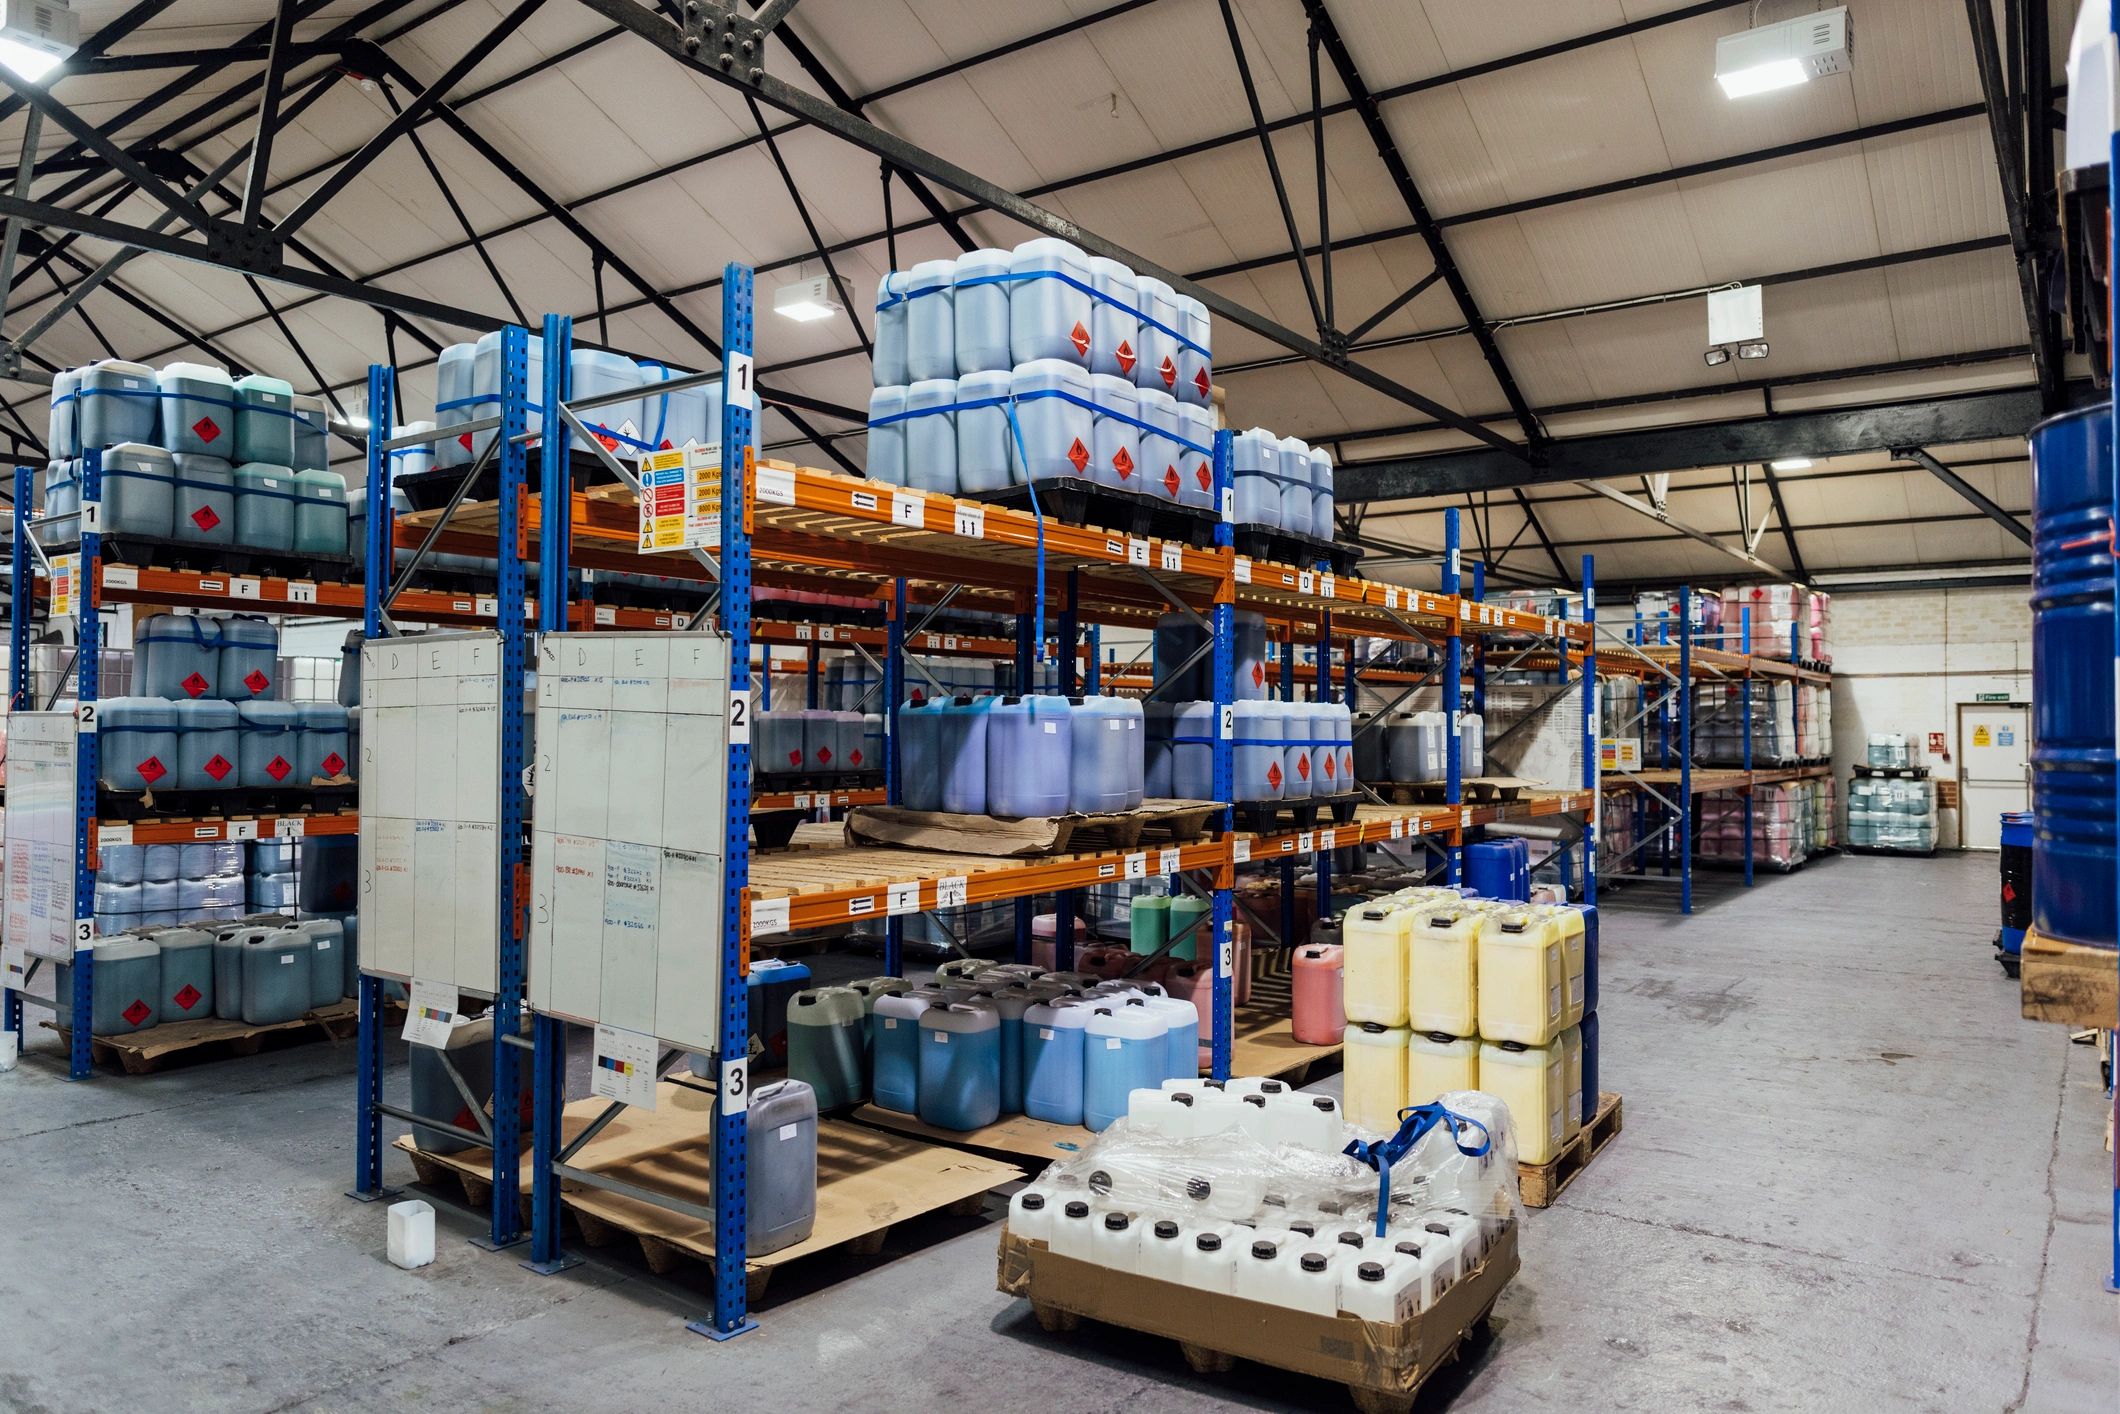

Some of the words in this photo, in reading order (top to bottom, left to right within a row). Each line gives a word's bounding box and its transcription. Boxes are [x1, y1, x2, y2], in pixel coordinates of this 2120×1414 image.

[738, 364, 747, 390] 1
[699, 472, 711, 480] 2000
[699, 488, 711, 497] 2000
[1226, 494, 1232, 512] 1
[86, 506, 96, 522] 1
[904, 504, 912, 518] F
[1136, 547, 1143, 560] E
[242, 585, 248, 594] F
[484, 604, 491, 612] E
[678, 618, 684, 627] D
[824, 631, 829, 639] C
[392, 653, 399, 670] D
[432, 650, 441, 670] E
[474, 648, 480, 665] F
[579, 648, 586, 666] D
[635, 649, 644, 666] E
[694, 649, 700, 664] F
[82, 706, 94, 722] 2
[730, 699, 745, 727] 2
[1225, 710, 1232, 728] 2
[366, 748, 372, 762] 2
[544, 755, 551, 772] 2
[239, 826, 246, 836] F
[1133, 862, 1138, 873] E
[365, 870, 372, 893] 3
[939, 880, 965, 890] BLACK
[900, 892, 907, 906] F
[538, 894, 549, 924] 3
[753, 919, 778, 928] 2000KGS
[79, 924, 91, 940] 3
[1225, 948, 1231, 966] 3
[730, 1068, 744, 1096] 3
